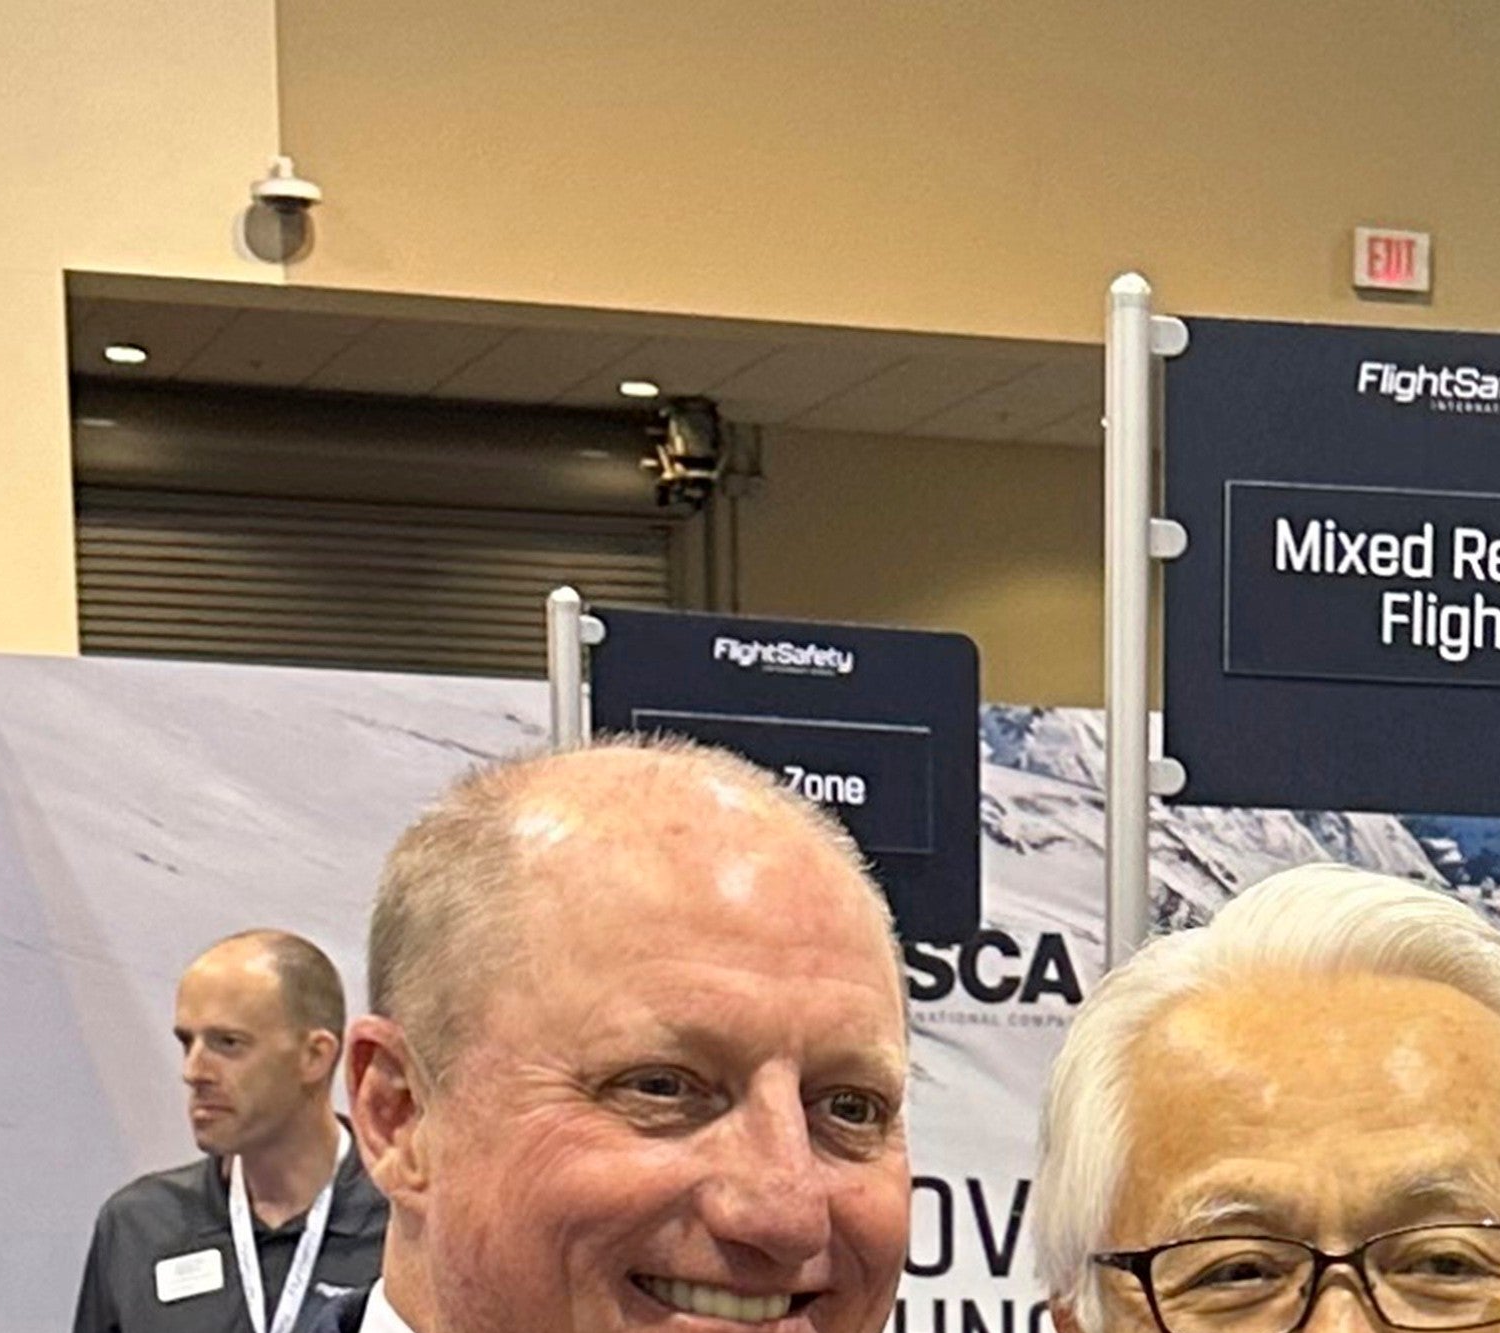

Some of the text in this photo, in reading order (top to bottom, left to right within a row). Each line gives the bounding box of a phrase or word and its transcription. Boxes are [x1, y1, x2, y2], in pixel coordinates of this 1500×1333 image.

[1275, 517, 1433, 580] Mixed
[713, 637, 853, 674] FlightSafety
[903, 929, 1084, 1006] SCA
